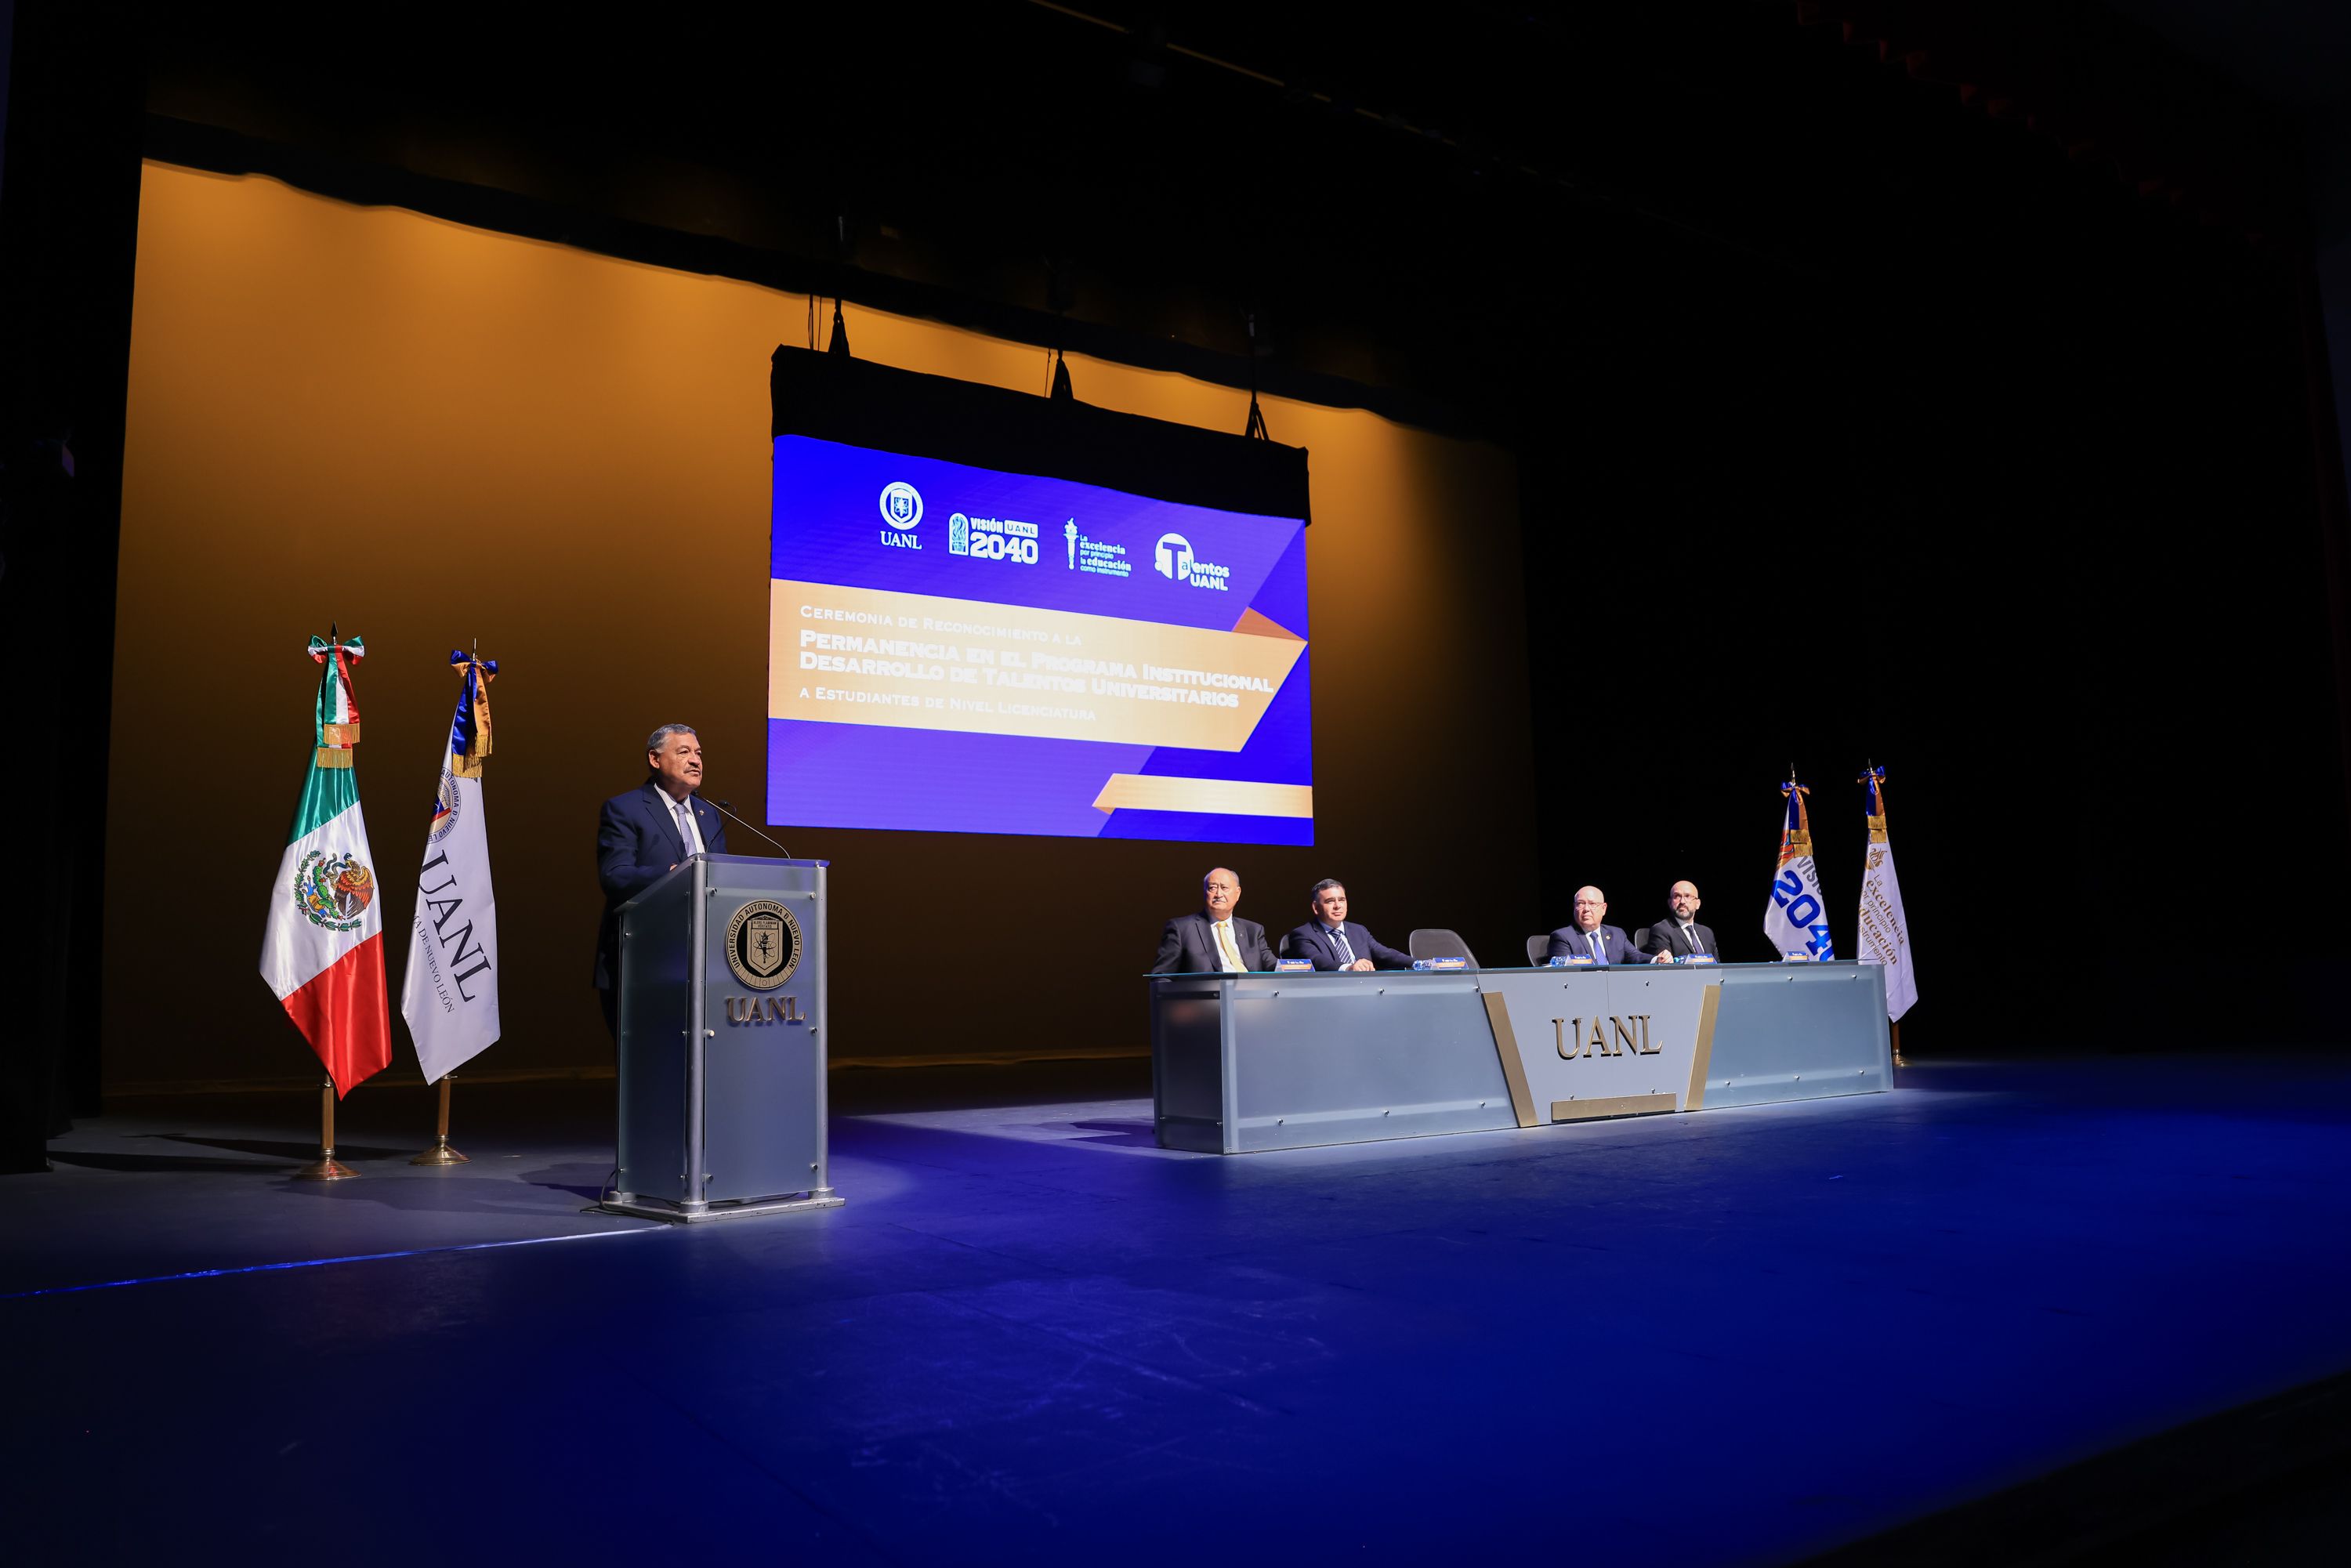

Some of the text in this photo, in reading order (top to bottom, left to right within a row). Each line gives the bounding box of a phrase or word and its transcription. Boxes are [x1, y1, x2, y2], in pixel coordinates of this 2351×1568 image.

[880, 531, 922, 550] UANL
[970, 517, 1035, 534] VISIÓN UANL
[970, 531, 1039, 565] 2040
[1080, 541, 1125, 555] excelencia
[1190, 574, 1229, 591] UANL
[800, 605, 1081, 646] CEREMONIA DE RECONOCIMIENTO A LA
[800, 629, 1274, 693] PERMANENCIA EN EL PROGRAMA INSTITUCIONAL
[799, 650, 1240, 708] DESARROLLO DE TALENTOS UNIVERSITARIOS
[799, 686, 1097, 721] A ESTUDIANTES DE NIVEL LICENCIATURA
[440, 770, 460, 808] AUTONOMA
[439, 817, 455, 838] NUEVO
[1874, 874, 1883, 887] La
[418, 849, 492, 1003] UANL
[744, 903, 783, 920] AUTONOMA
[1865, 900, 1891, 933] principio
[1866, 880, 1905, 945] excelencia
[728, 914, 744, 969] UNIVERSIDAD
[789, 919, 800, 947] NUEVO
[418, 928, 429, 945] DE
[425, 944, 441, 983] NUEVO
[436, 983, 455, 1013] LEÓN
[788, 948, 800, 969] LEON
[726, 996, 806, 1023] UANL
[1551, 1015, 1663, 1060] UANL
